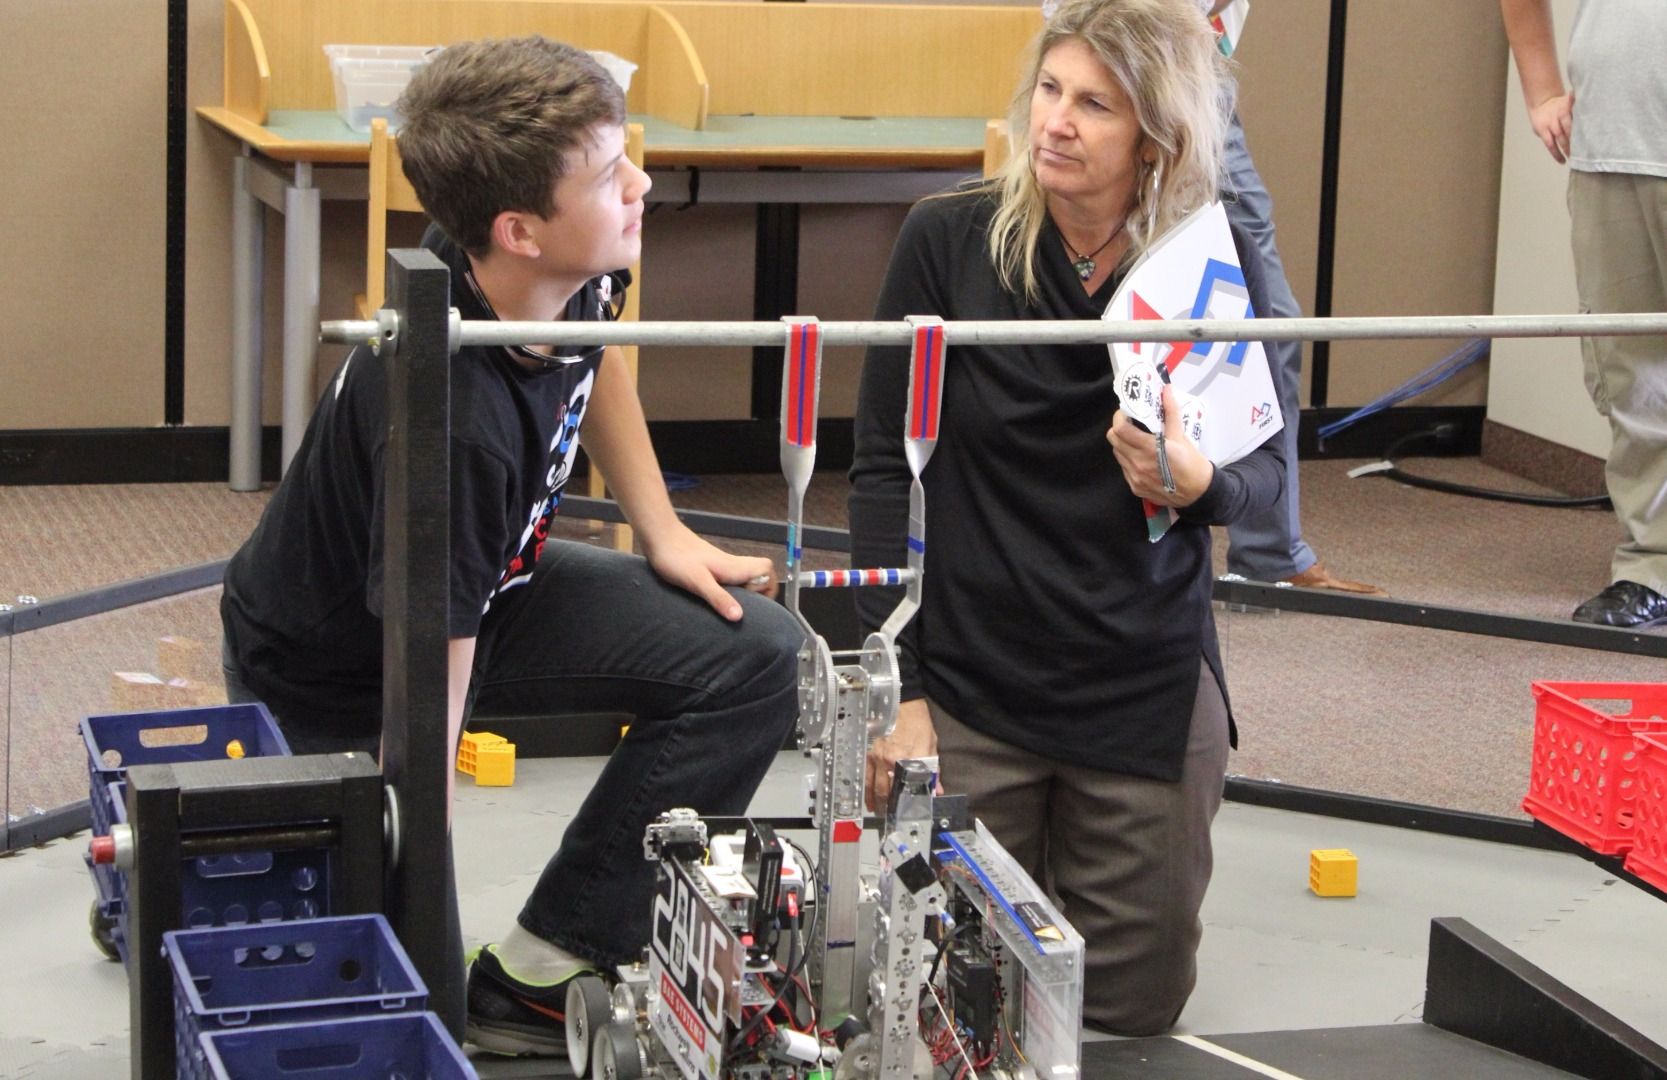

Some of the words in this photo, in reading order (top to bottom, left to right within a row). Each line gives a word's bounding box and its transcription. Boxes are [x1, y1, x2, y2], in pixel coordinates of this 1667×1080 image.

[653, 860, 727, 1034] 2845
[663, 977, 675, 1006] BAE
[675, 996, 704, 1045] SYSTEMS
